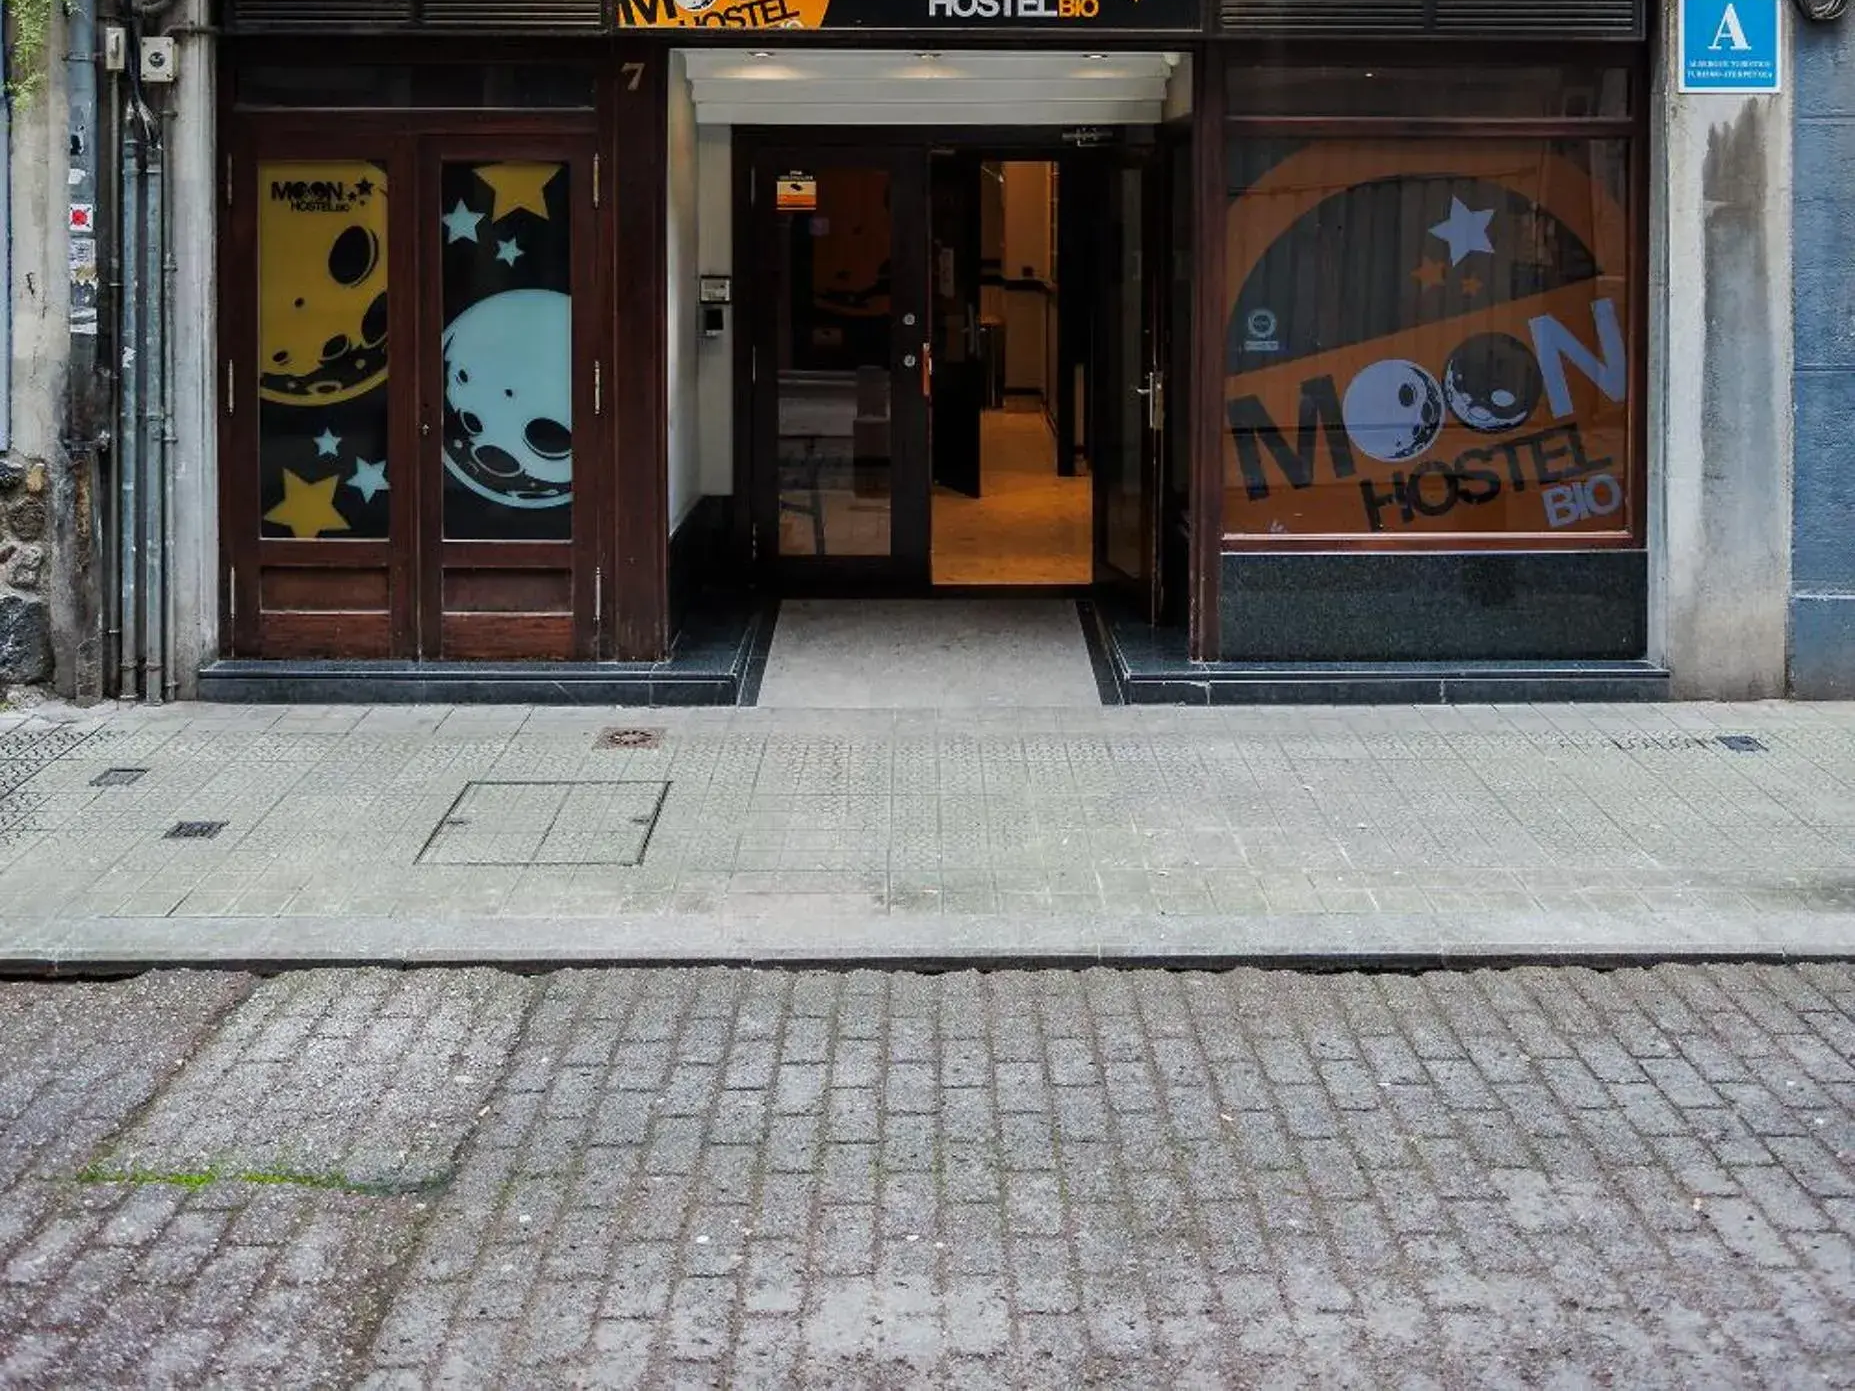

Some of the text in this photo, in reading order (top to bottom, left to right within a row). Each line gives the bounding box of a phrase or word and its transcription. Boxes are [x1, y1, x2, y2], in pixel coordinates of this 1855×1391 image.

[1708, 2, 1752, 51] A
[620, 62, 645, 91] 7
[271, 181, 343, 202] MOON
[1228, 298, 1628, 502] MOON
[1359, 423, 1622, 533] HOSTEL BIO
